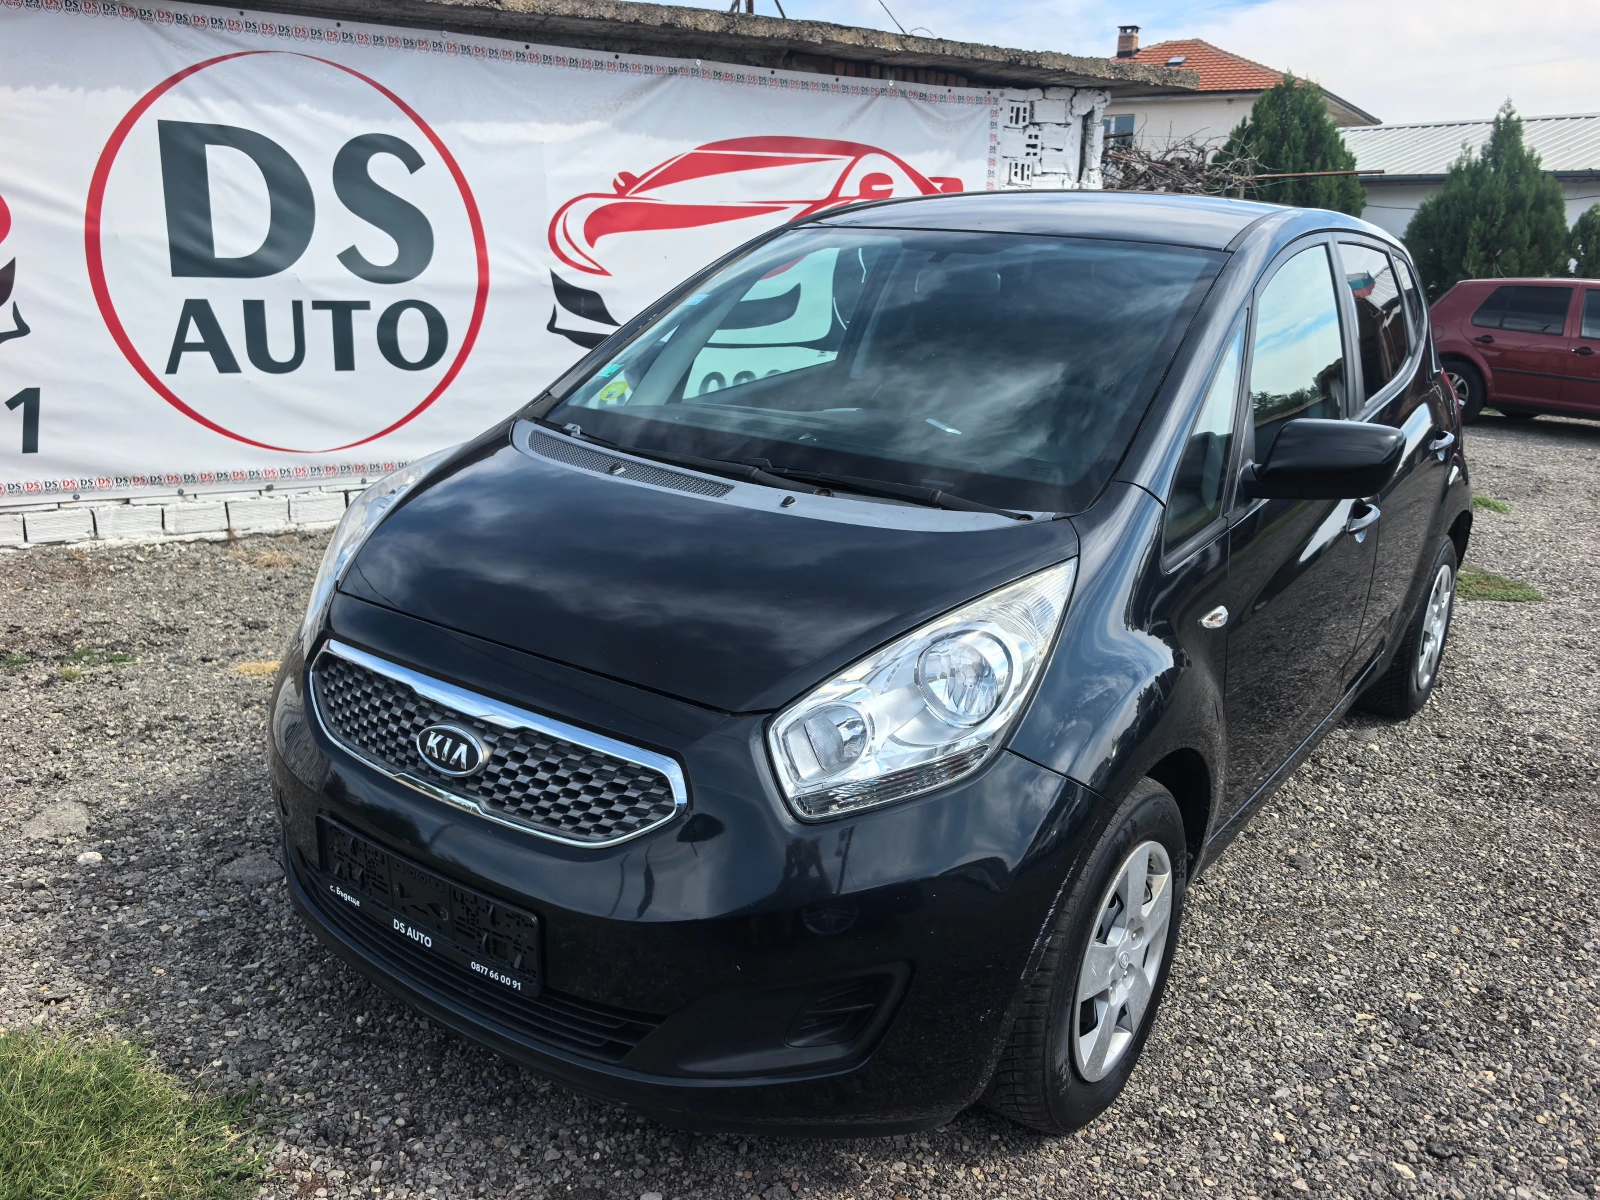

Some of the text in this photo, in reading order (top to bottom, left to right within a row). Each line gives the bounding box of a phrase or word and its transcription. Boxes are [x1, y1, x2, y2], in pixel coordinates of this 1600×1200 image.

[65, 0, 78, 8] DS
[176, 13, 188, 21] DS
[279, 25, 290, 33] DS
[358, 33, 368, 41] DS
[157, 119, 435, 285] DS
[165, 299, 449, 375] AUTO
[4, 387, 41, 454] 1
[45, 480, 57, 488] DS
[425, 731, 468, 770] KIA
[393, 918, 432, 948] DS AUTO
[471, 961, 521, 991] 0877 66 00 91
